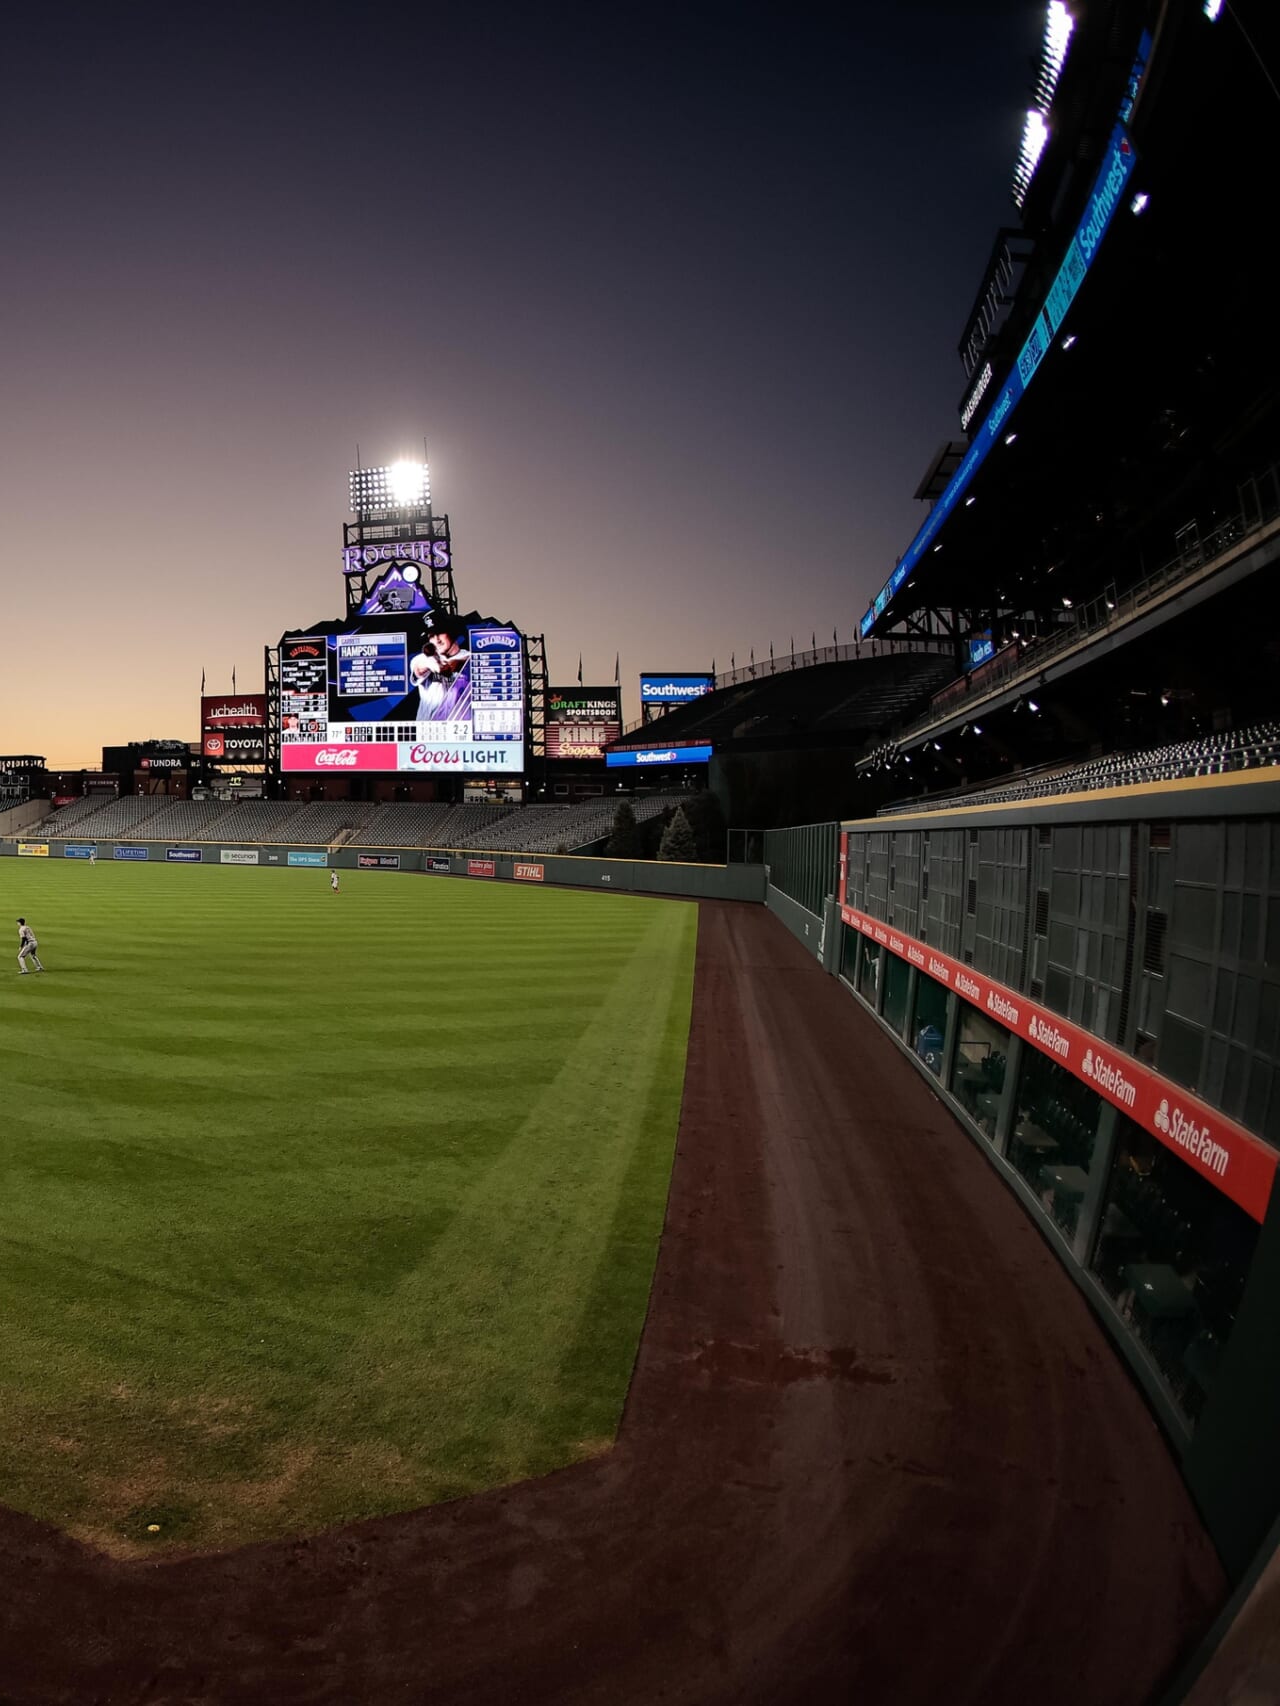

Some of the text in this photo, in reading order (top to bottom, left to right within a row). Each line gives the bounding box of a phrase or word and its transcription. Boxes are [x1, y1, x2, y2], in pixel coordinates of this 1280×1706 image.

[1080, 148, 1127, 260] Southwest
[342, 541, 450, 573] ROCKIES
[476, 636, 516, 649] COLORADO
[341, 645, 378, 657] HAMPSON
[642, 684, 706, 696] Southwest
[211, 703, 258, 718] uchealth
[550, 701, 617, 710] DRAFTKINGS
[559, 728, 606, 743] KING
[224, 739, 264, 749] TOYOTA
[410, 744, 508, 764] Coors LIGHT
[559, 743, 603, 758] Sooper
[150, 759, 182, 768] TUNDRA
[636, 752, 672, 763] Southwest
[516, 866, 542, 878] STIHL
